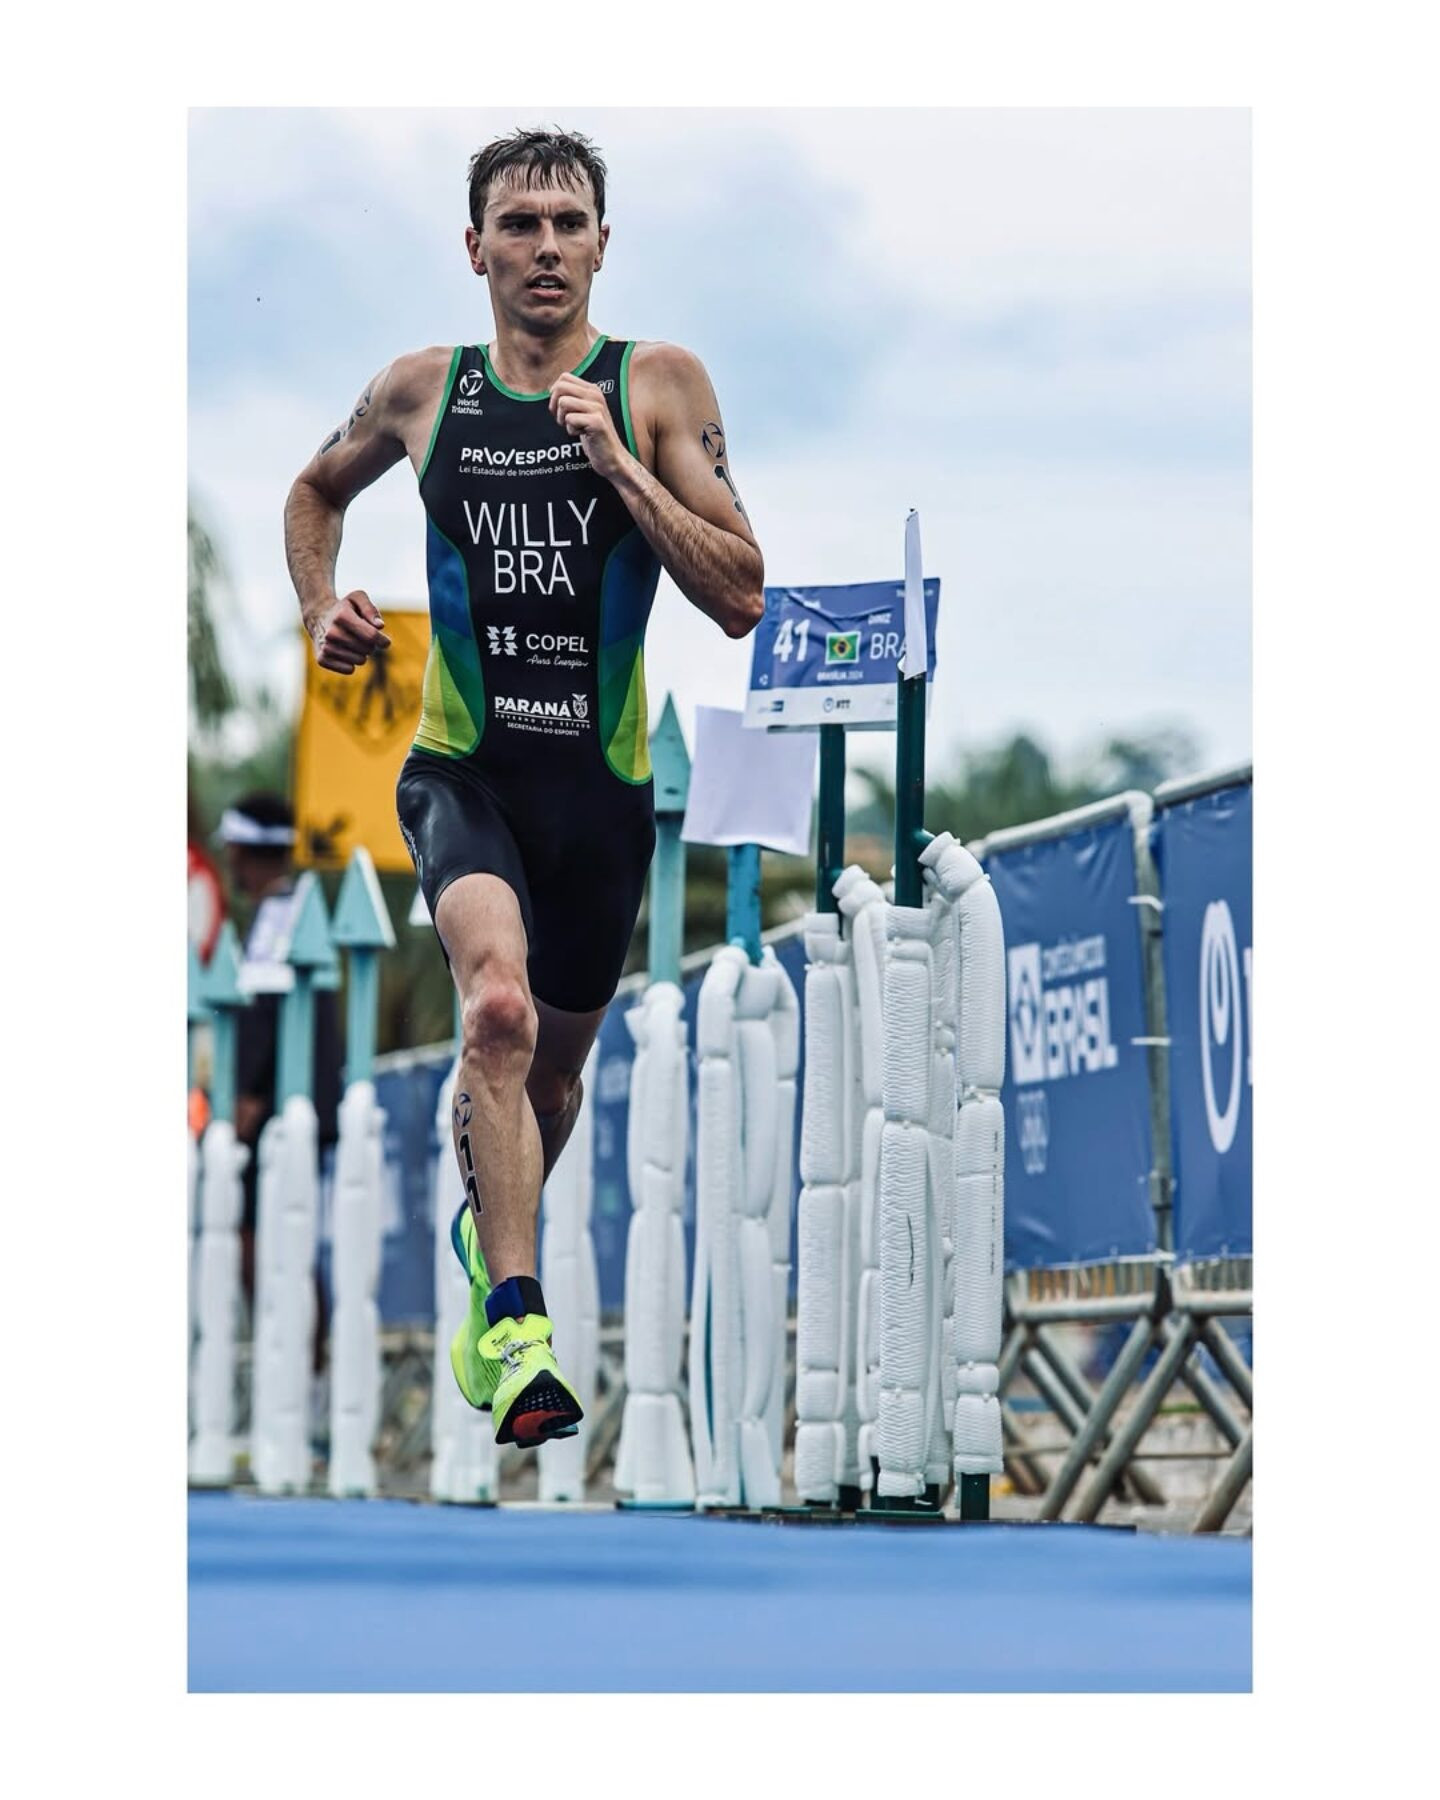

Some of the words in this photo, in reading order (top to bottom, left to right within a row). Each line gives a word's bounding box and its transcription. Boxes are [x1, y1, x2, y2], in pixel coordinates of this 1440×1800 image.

[451, 406, 483, 416] Triathlon
[457, 399, 479, 407] World
[459, 465, 471, 473] Lei
[472, 466, 506, 476] Estadual
[506, 468, 517, 477] de
[518, 465, 553, 476] Incentivo
[554, 464, 564, 473] ao
[463, 498, 598, 548] WILLY
[494, 550, 576, 597] BRA
[525, 634, 589, 653] COPEL
[773, 618, 811, 663] 41
[494, 696, 571, 717] PARANÁ
[1043, 977, 1118, 1079] BRASIL
[460, 1132, 483, 1214] 11
